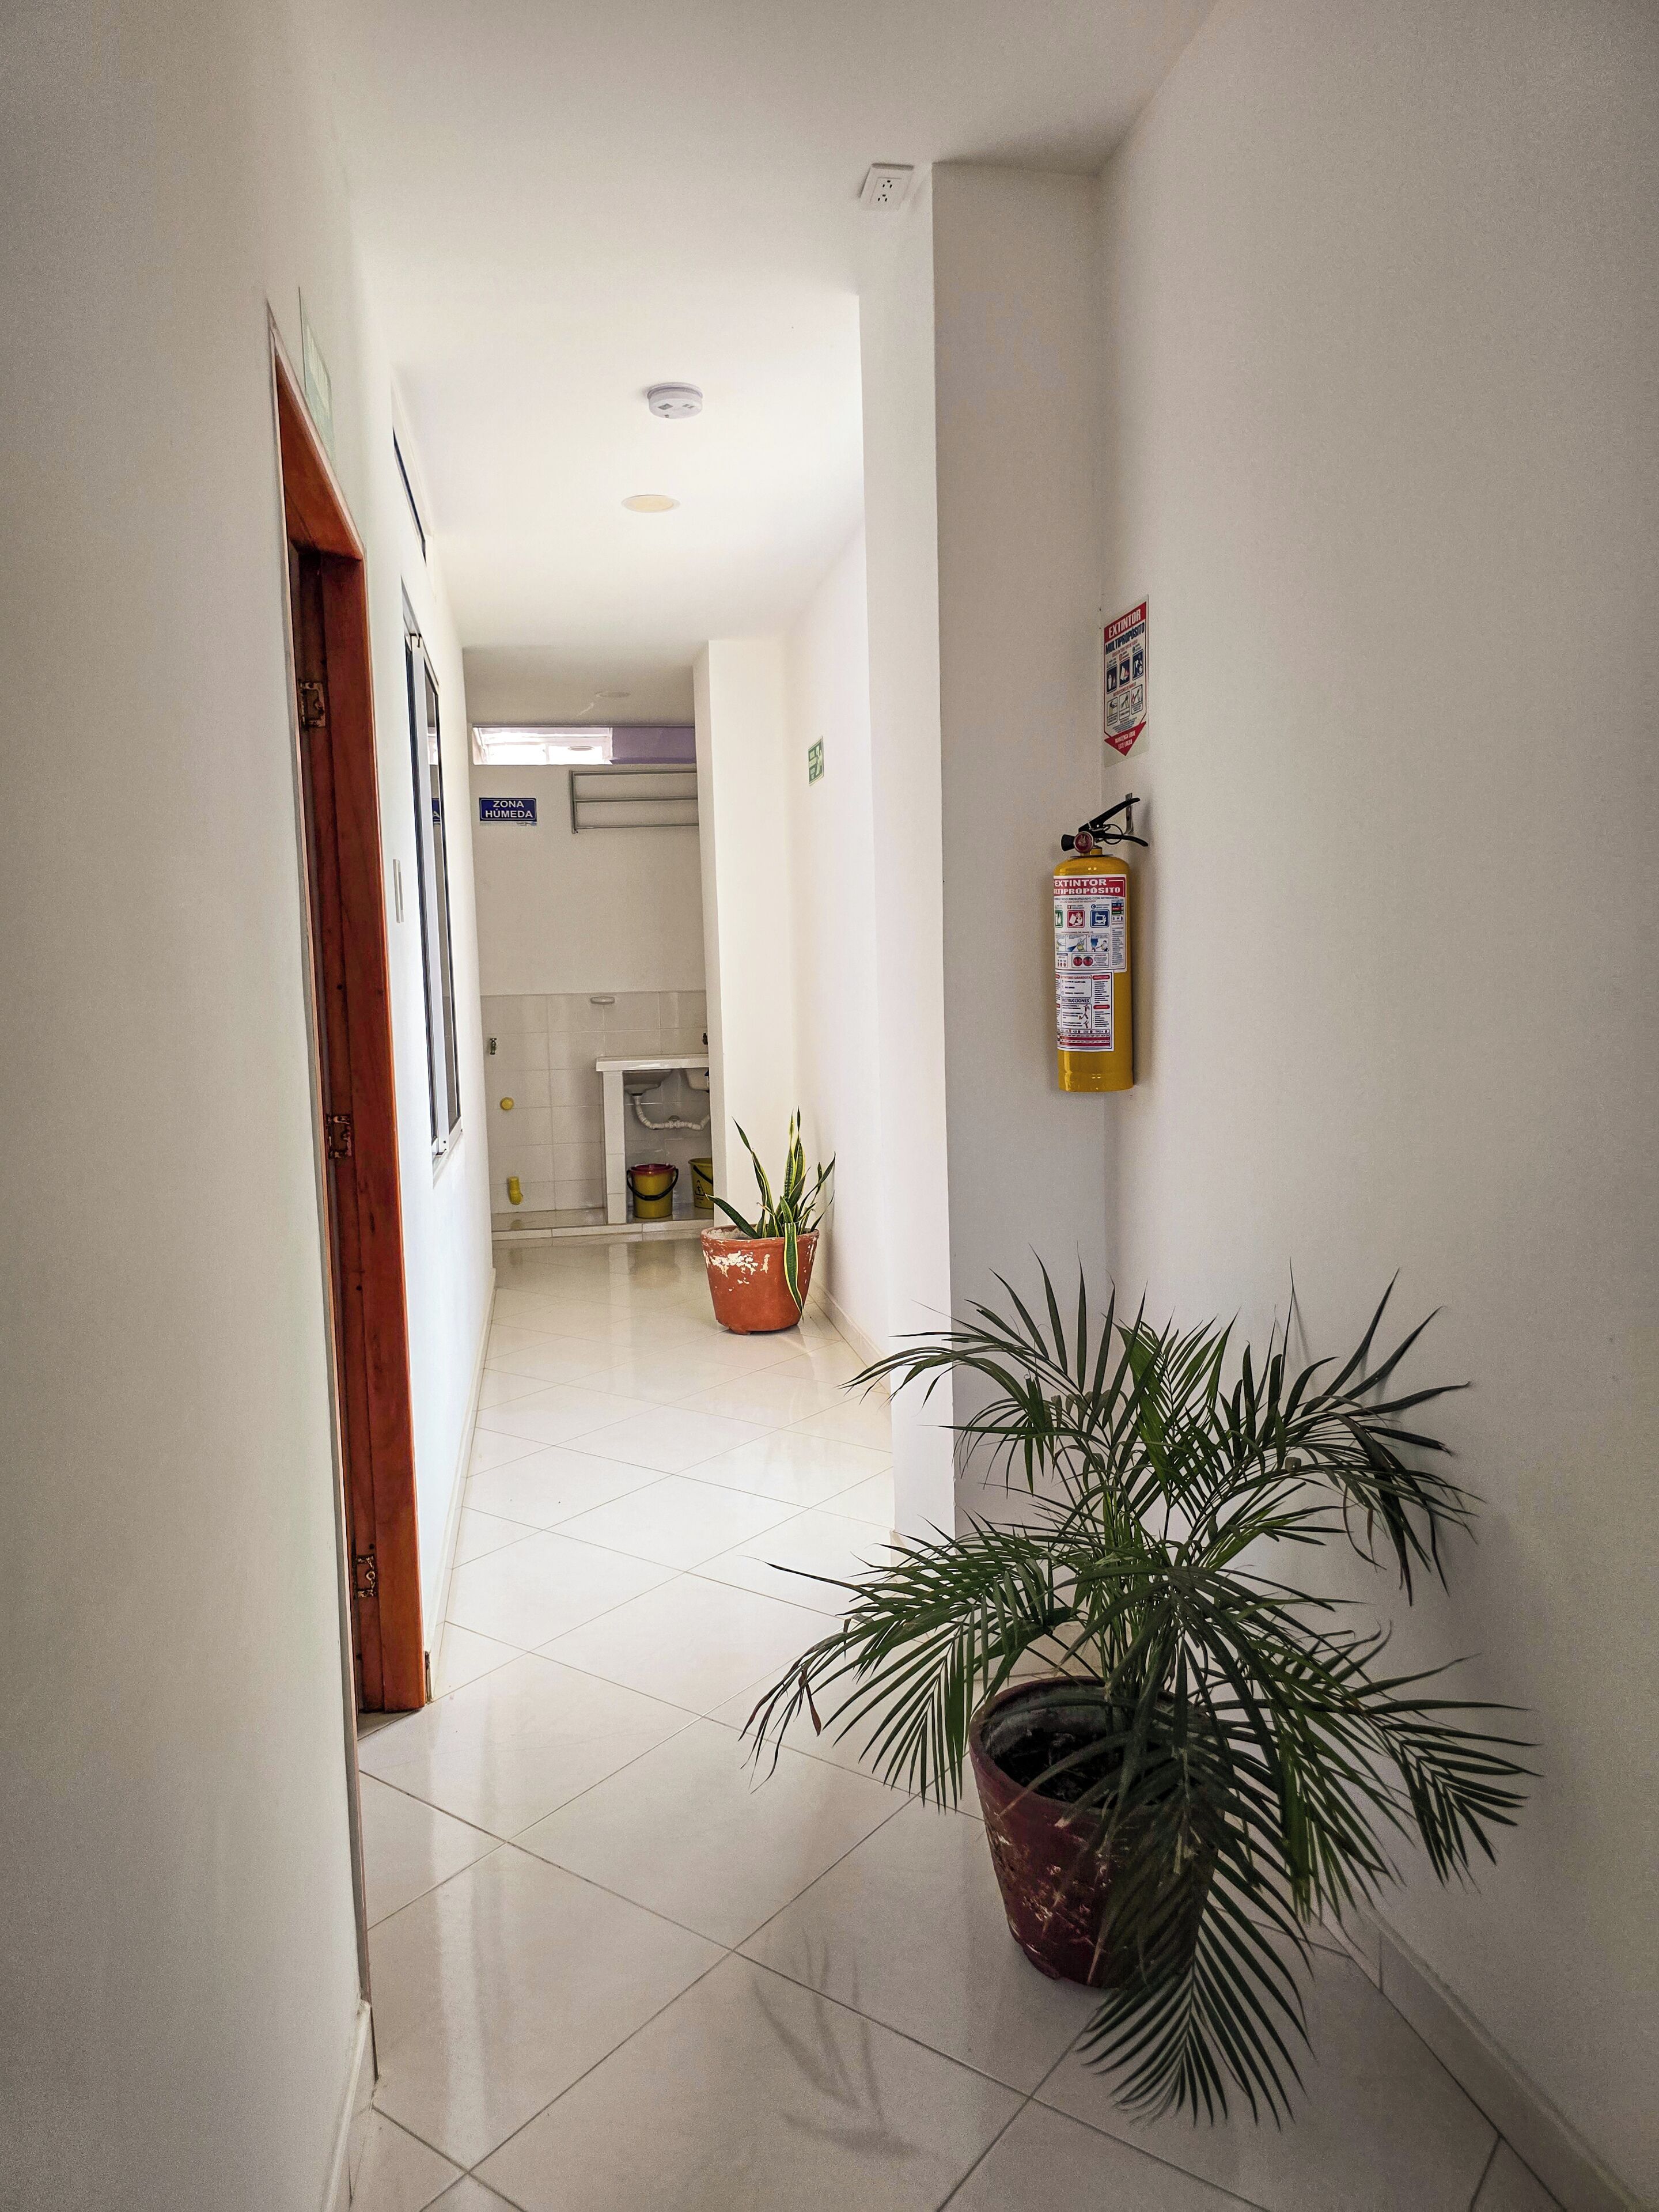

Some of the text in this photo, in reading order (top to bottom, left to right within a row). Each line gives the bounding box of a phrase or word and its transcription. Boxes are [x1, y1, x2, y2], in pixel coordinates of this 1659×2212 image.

[1109, 609, 1141, 639] EXTINTOR
[1105, 622, 1145, 655] MULTIPROPÓSITO
[485, 808, 533, 818] HÚMEDA
[1055, 879, 1107, 887] EXTINTOR
